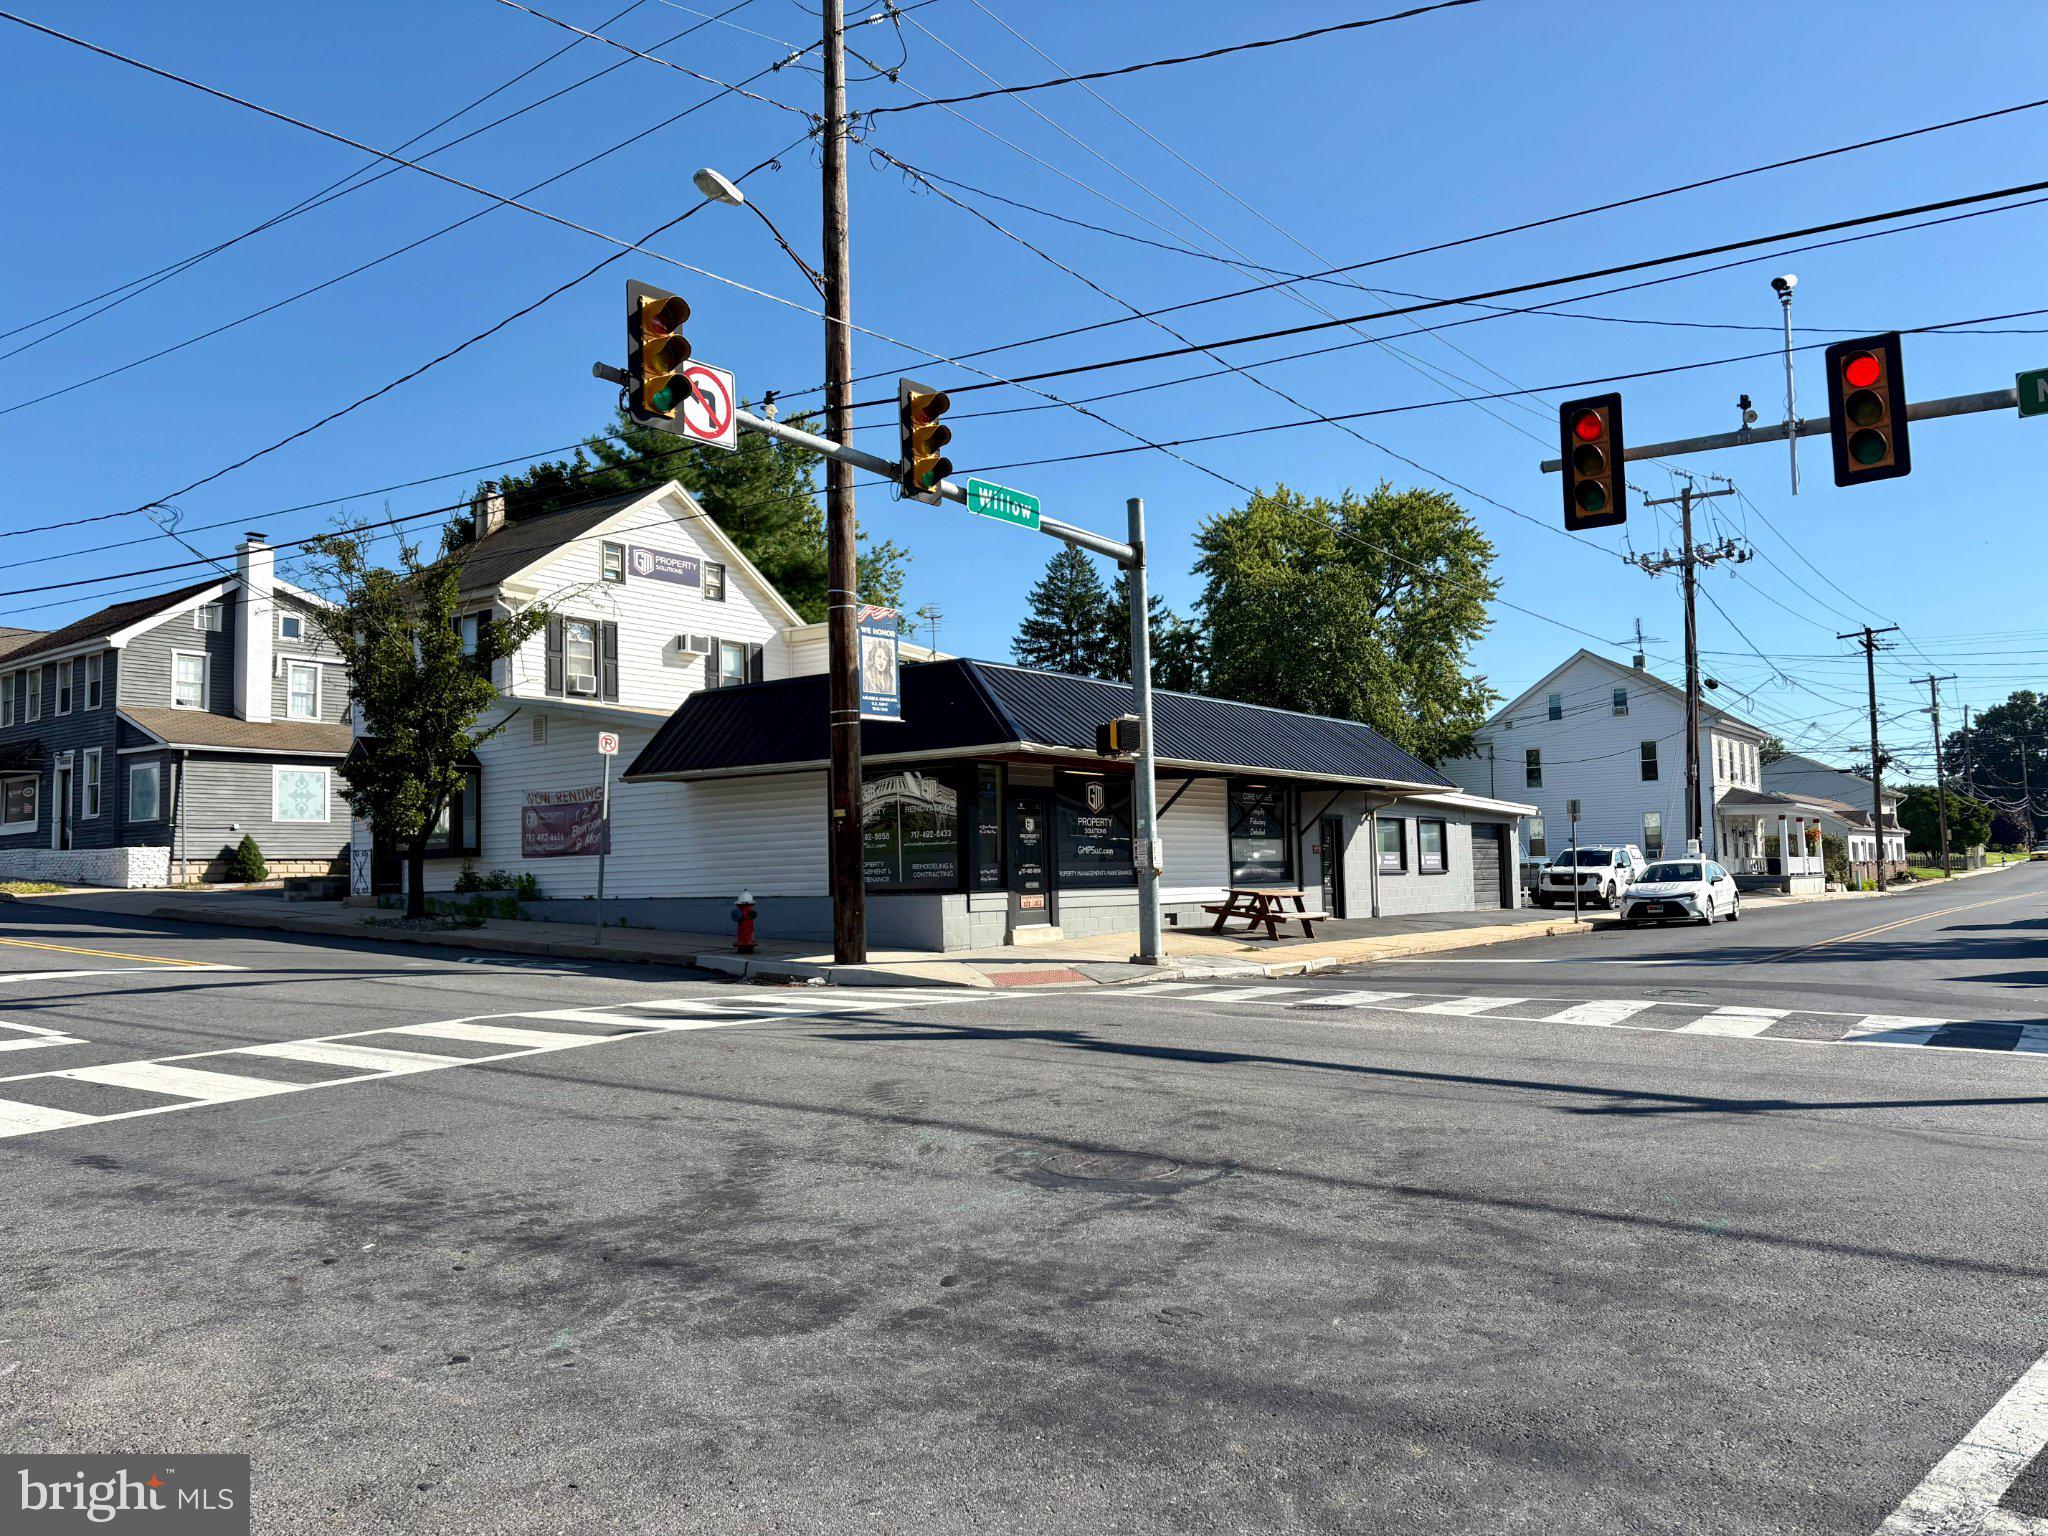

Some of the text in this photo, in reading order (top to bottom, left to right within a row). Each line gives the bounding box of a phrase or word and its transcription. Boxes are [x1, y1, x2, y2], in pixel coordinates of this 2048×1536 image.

[978, 487, 1032, 519] Willow
[655, 556, 698, 571] PROPERTY
[655, 565, 683, 574] SOLUTIONS
[861, 626, 896, 638] WE HONOR
[527, 787, 602, 804] NOW RENTING
[1077, 817, 1113, 827] PROPERTY
[912, 862, 949, 870] REMODELING
[912, 870, 954, 878] CONTRACTING
